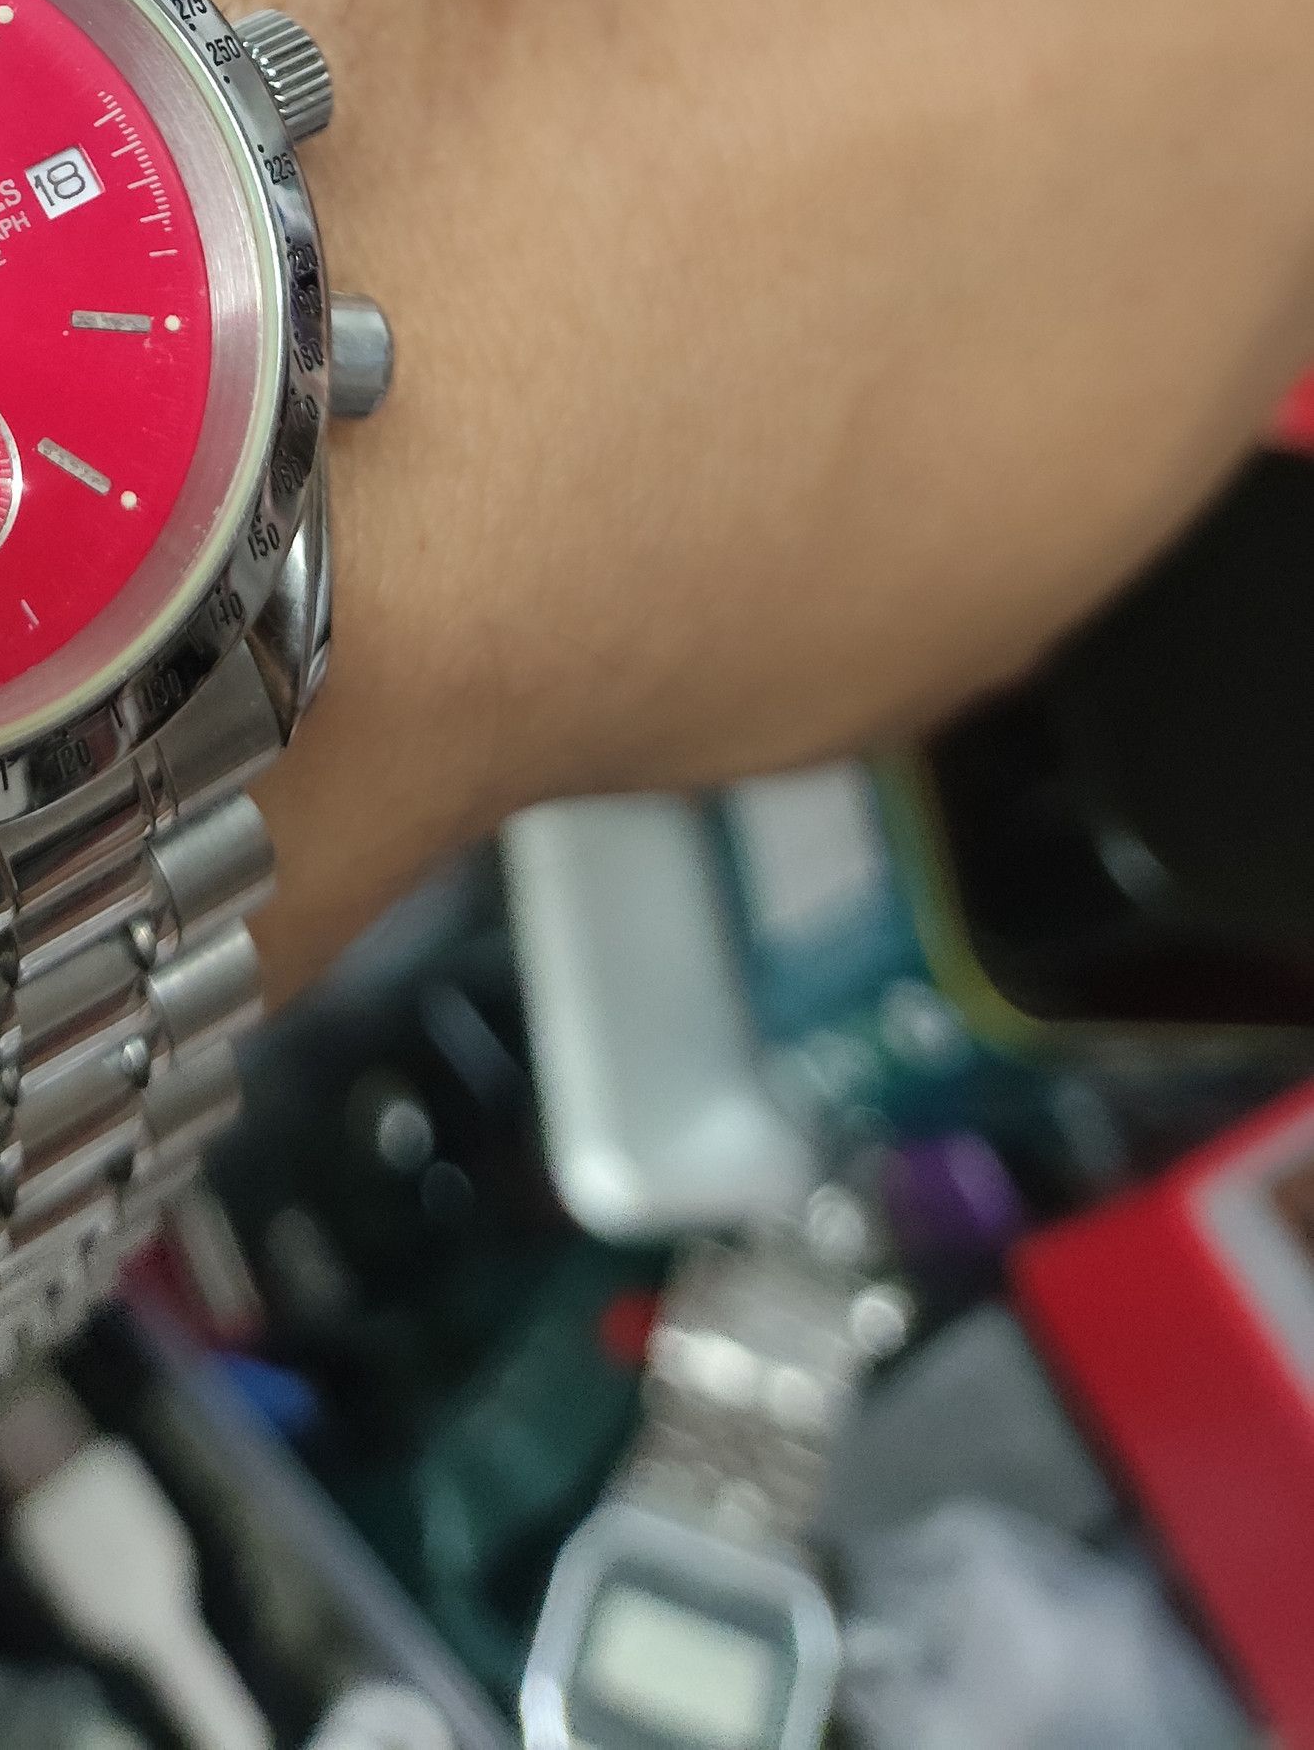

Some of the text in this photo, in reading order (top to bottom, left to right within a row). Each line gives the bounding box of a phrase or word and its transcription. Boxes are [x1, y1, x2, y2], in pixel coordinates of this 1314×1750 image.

[205, 34, 241, 67] 250
[33, 159, 87, 207] 18
[263, 151, 298, 186] 225
[292, 339, 326, 374] 180
[247, 520, 282, 563] 150
